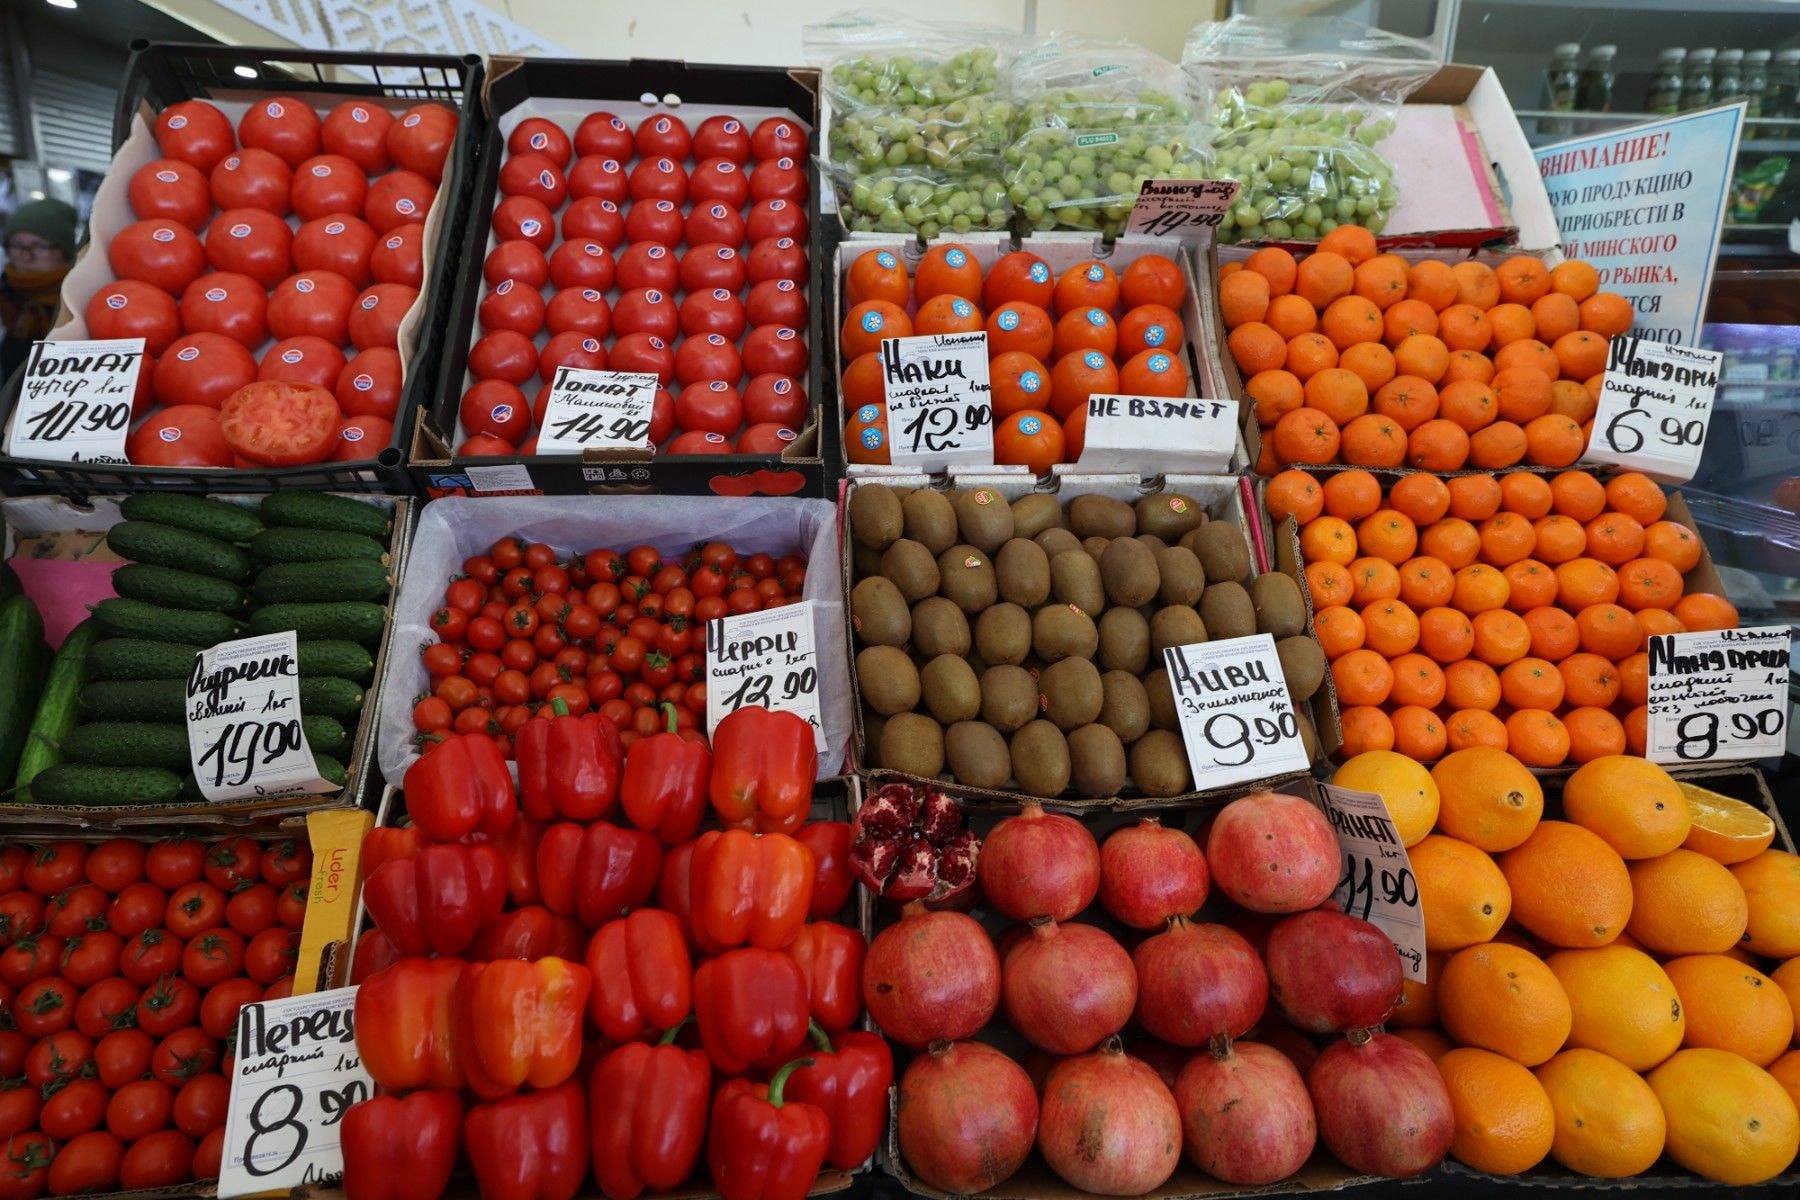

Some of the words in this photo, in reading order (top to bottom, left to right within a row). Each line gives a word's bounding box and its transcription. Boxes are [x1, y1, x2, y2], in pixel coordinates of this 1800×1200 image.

[1540, 131, 1671, 178] ВНИМАНИЕ!
[1582, 170, 1693, 204] ПРОДУКЦИЮ
[1562, 204, 1669, 233] ПРИОБРЕСТИ
[1673, 202, 1686, 221] В
[1583, 234, 1678, 258] МИНСКОГО
[1613, 265, 1679, 286] РЫНКА,
[1089, 398, 1121, 417] НЕ
[1128, 398, 1227, 419] ВЯЖЕТ
[1165, 646, 1270, 696] Киви
